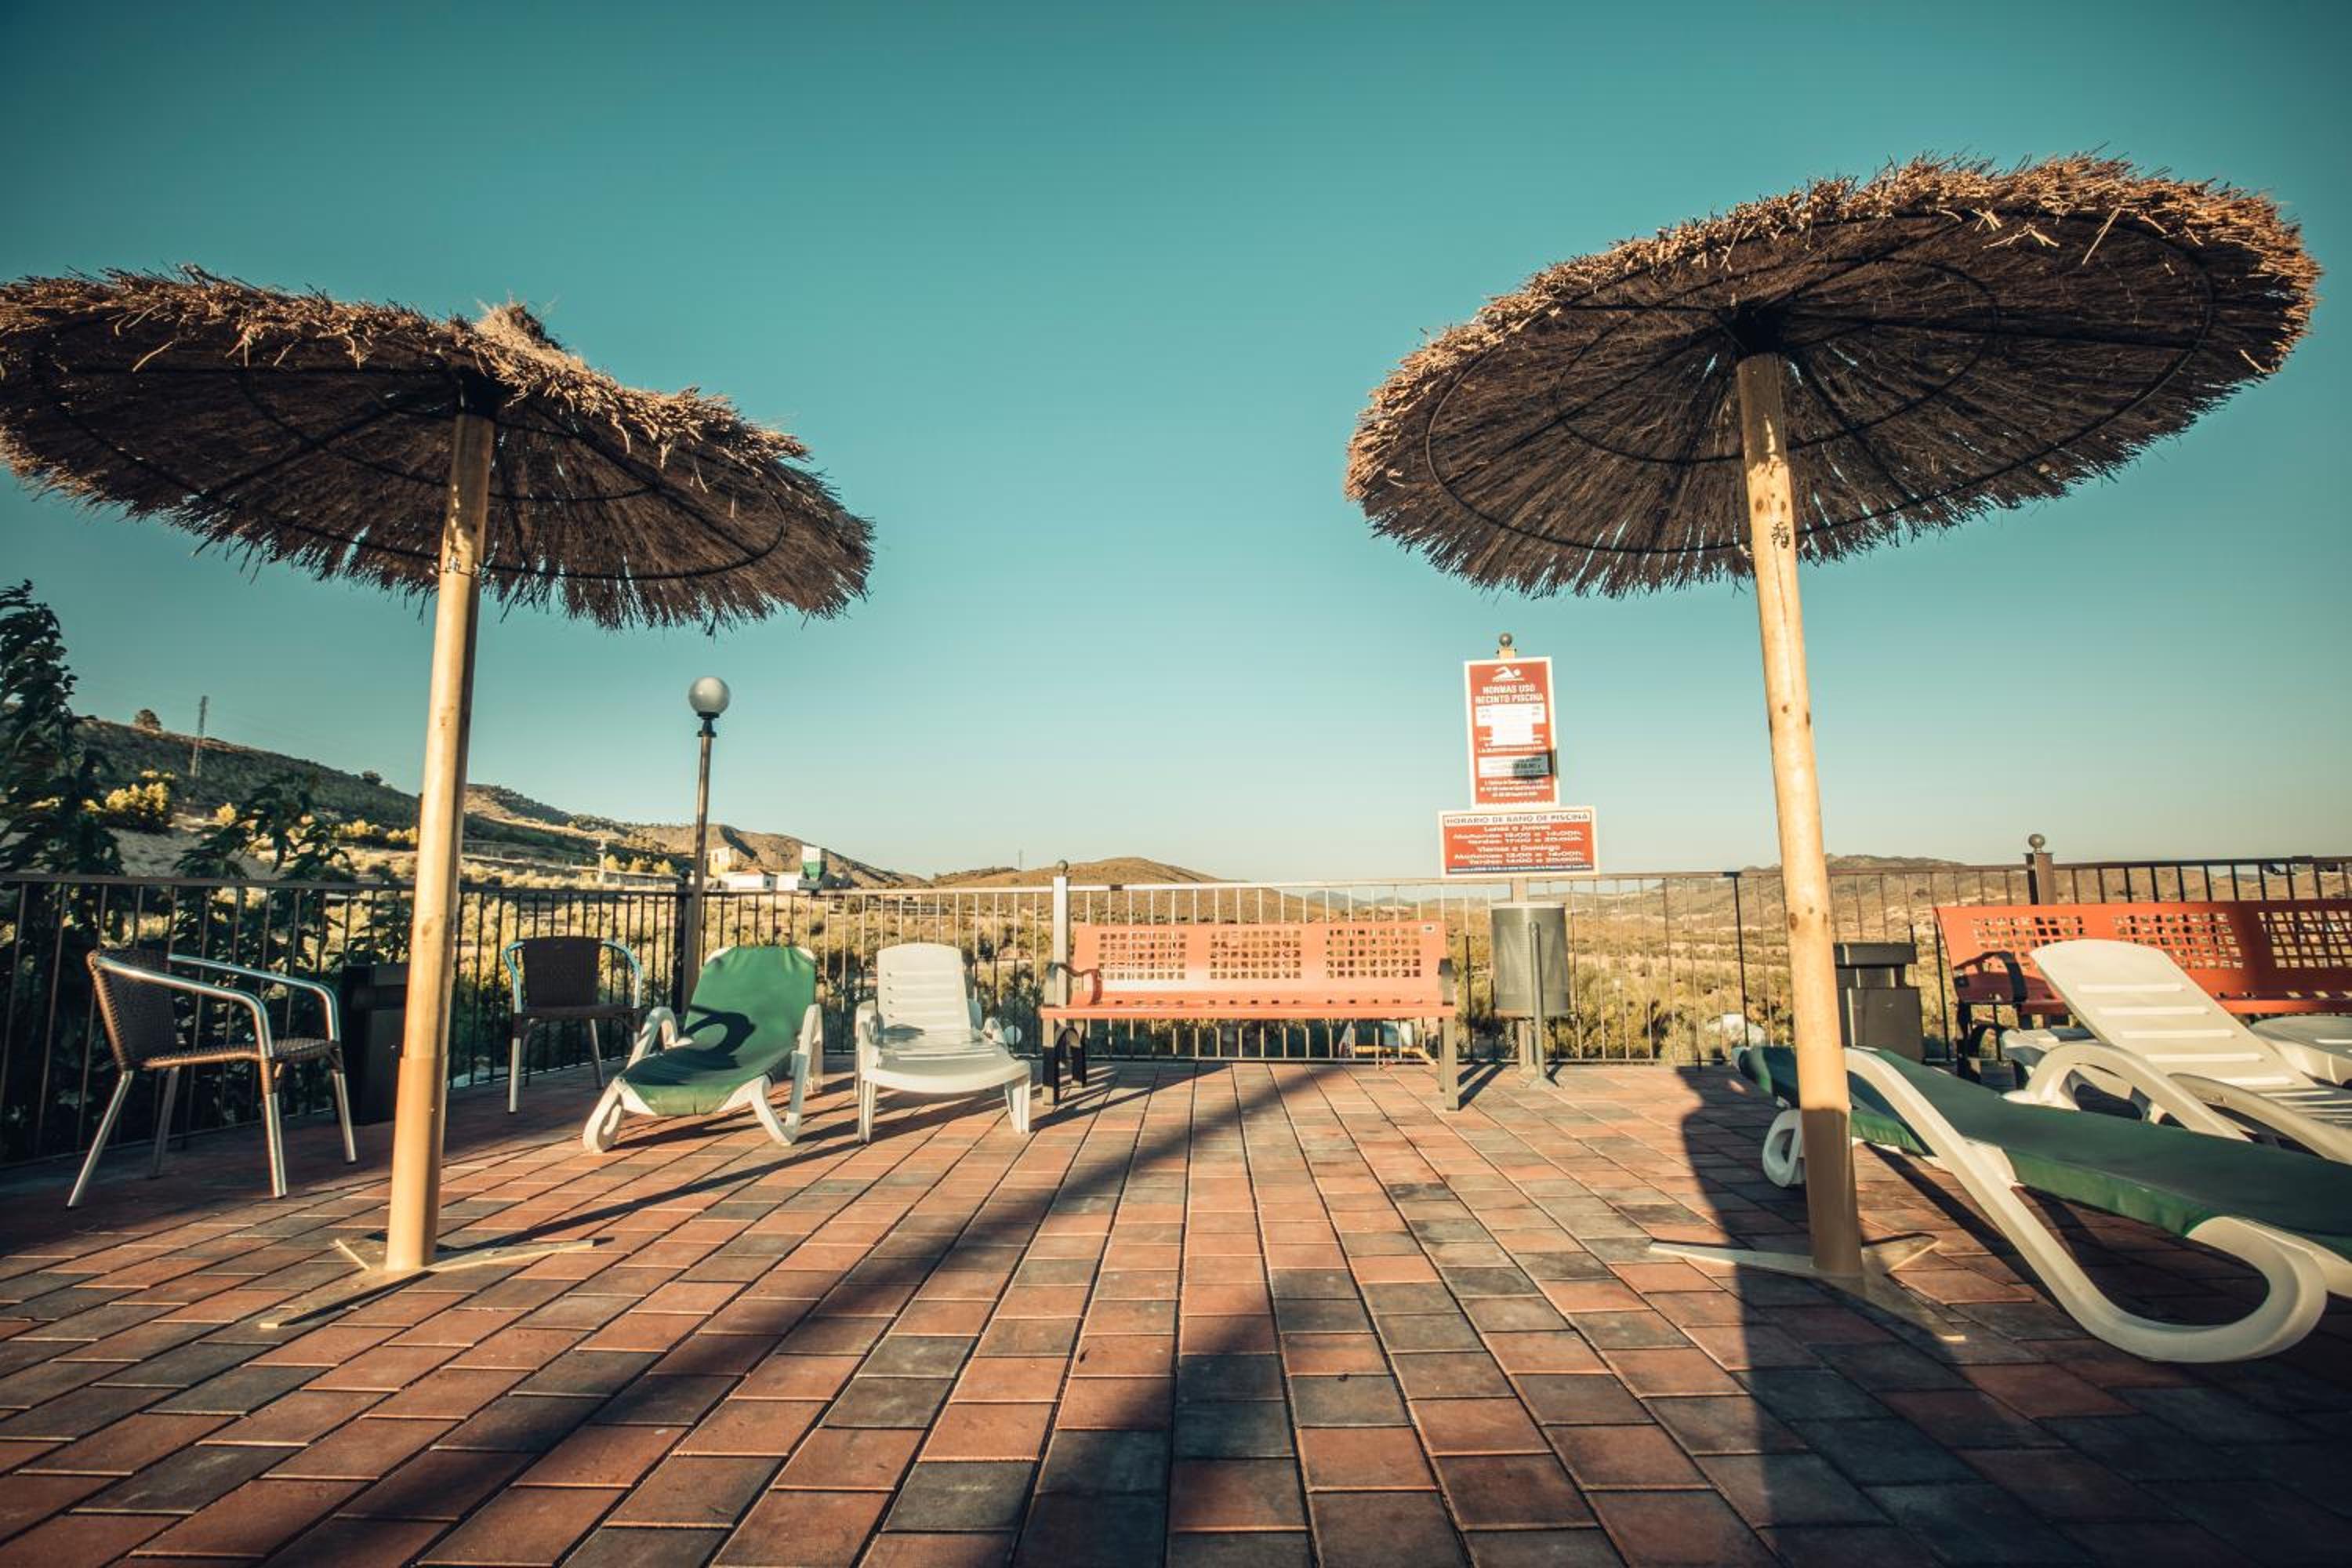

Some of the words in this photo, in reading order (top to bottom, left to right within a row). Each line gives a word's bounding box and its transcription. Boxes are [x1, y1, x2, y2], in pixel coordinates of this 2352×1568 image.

[1482, 684, 1517, 694] NORMAS
[1519, 684, 1535, 692] USO
[1512, 693, 1544, 702] PISCINA
